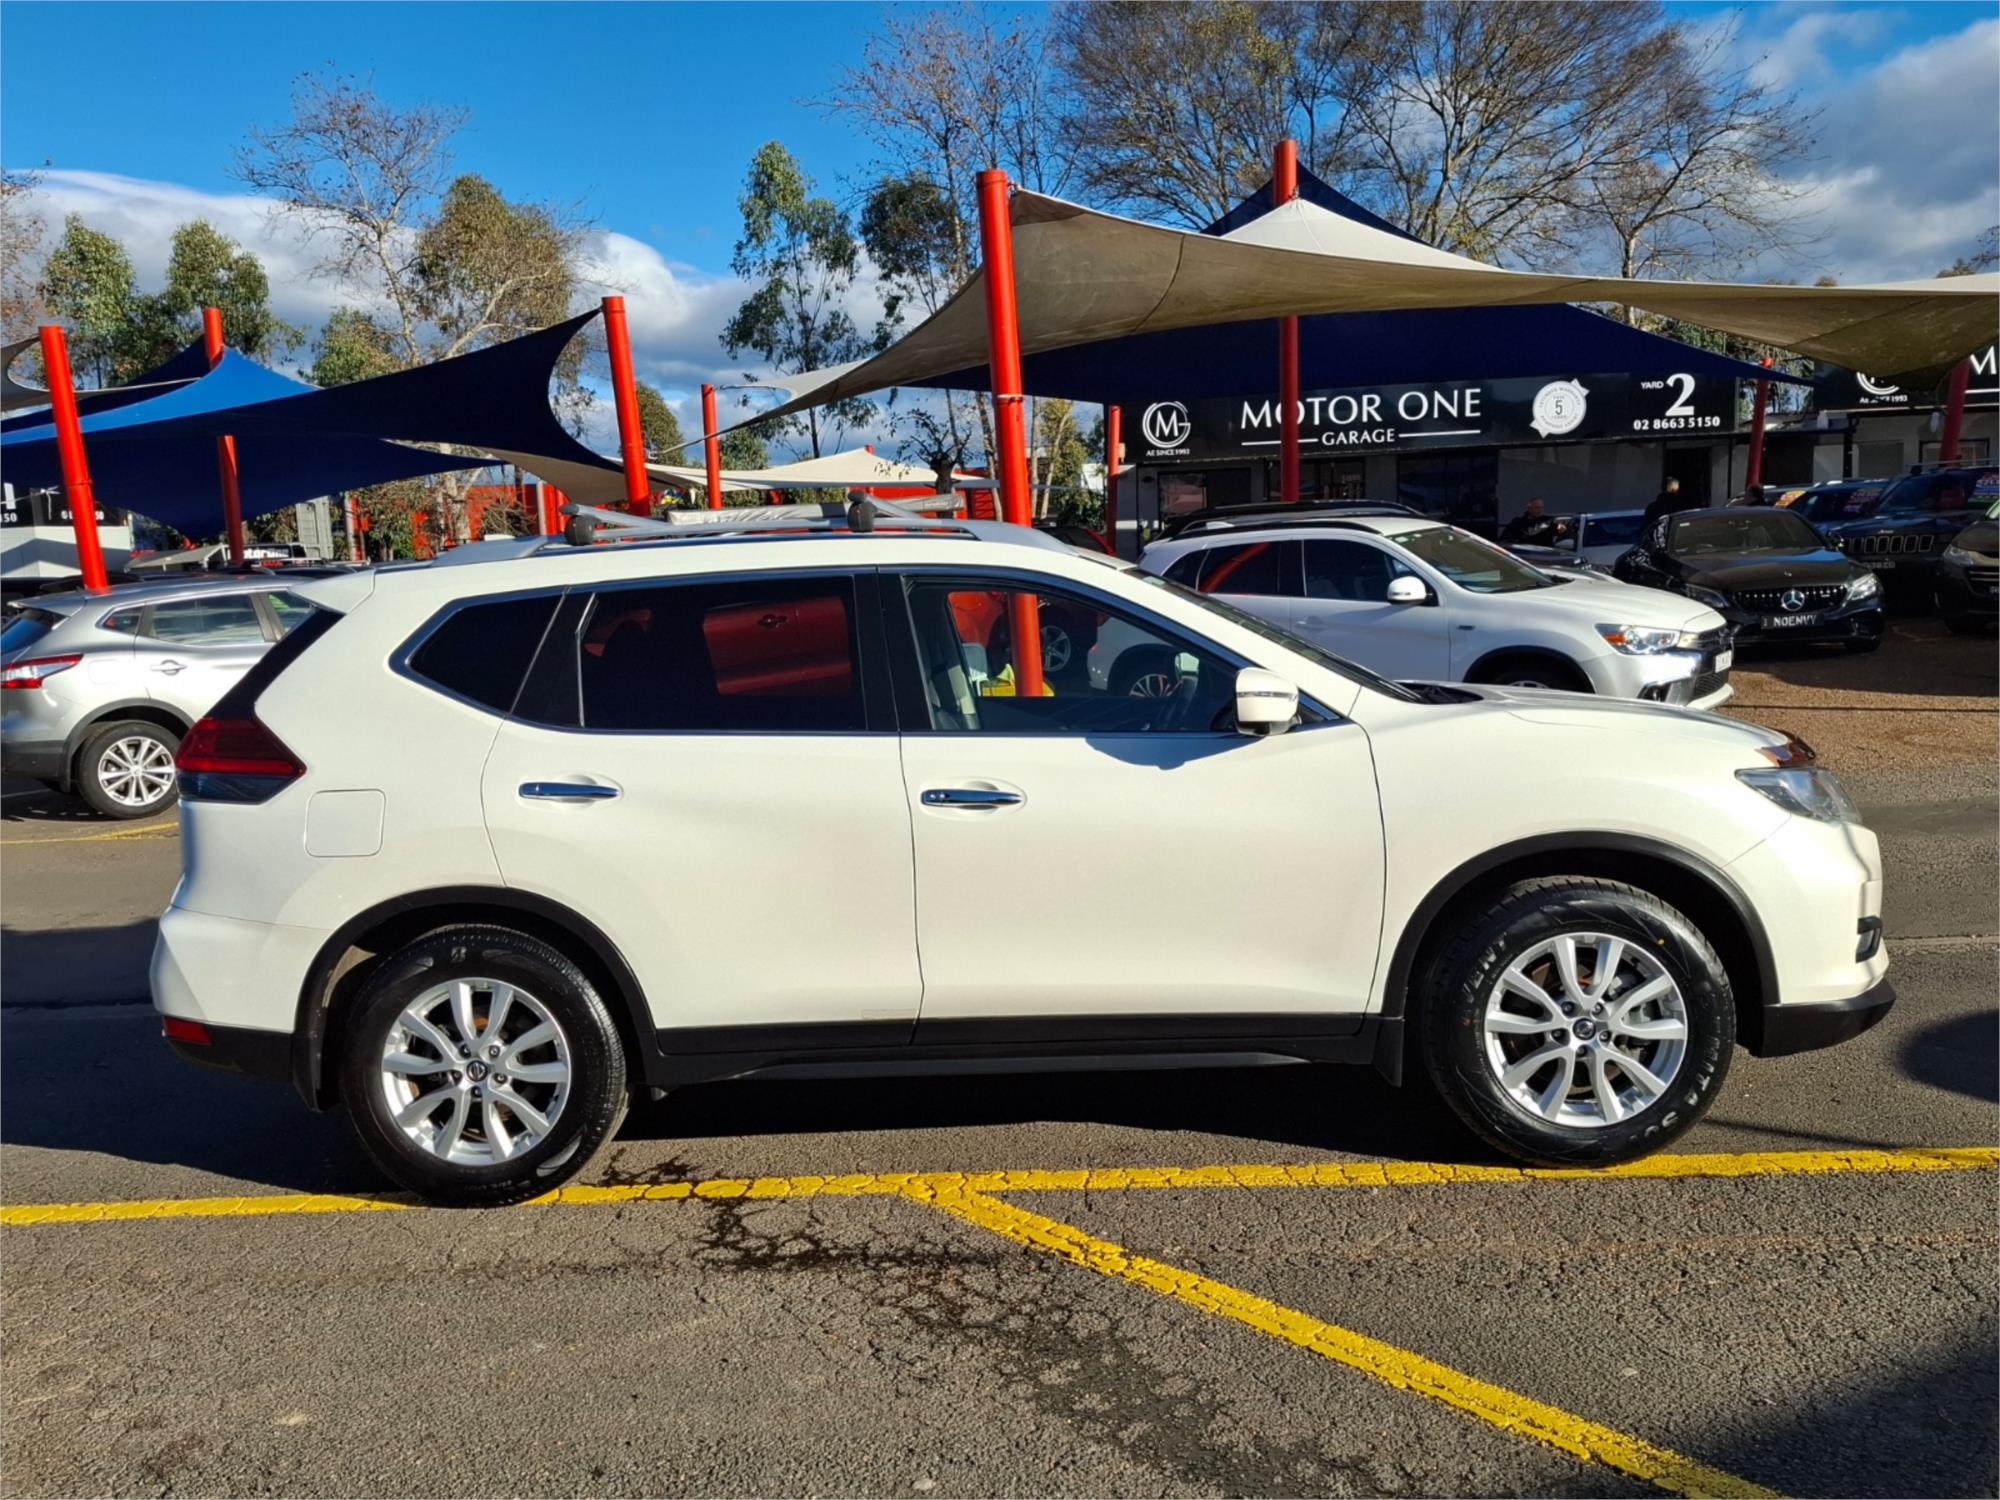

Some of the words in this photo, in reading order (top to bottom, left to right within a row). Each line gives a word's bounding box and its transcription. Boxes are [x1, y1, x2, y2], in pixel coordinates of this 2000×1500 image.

[1640, 381, 1664, 389] YARD
[1665, 373, 1695, 416] 2
[1241, 394, 1383, 430] MOTOR
[1398, 388, 1481, 421] ONE
[1555, 400, 1563, 415] 5
[1633, 419, 1649, 430] 02
[1653, 417, 1685, 429] 8663
[1688, 416, 1720, 428] 5150
[1321, 429, 1395, 446] GARAGE
